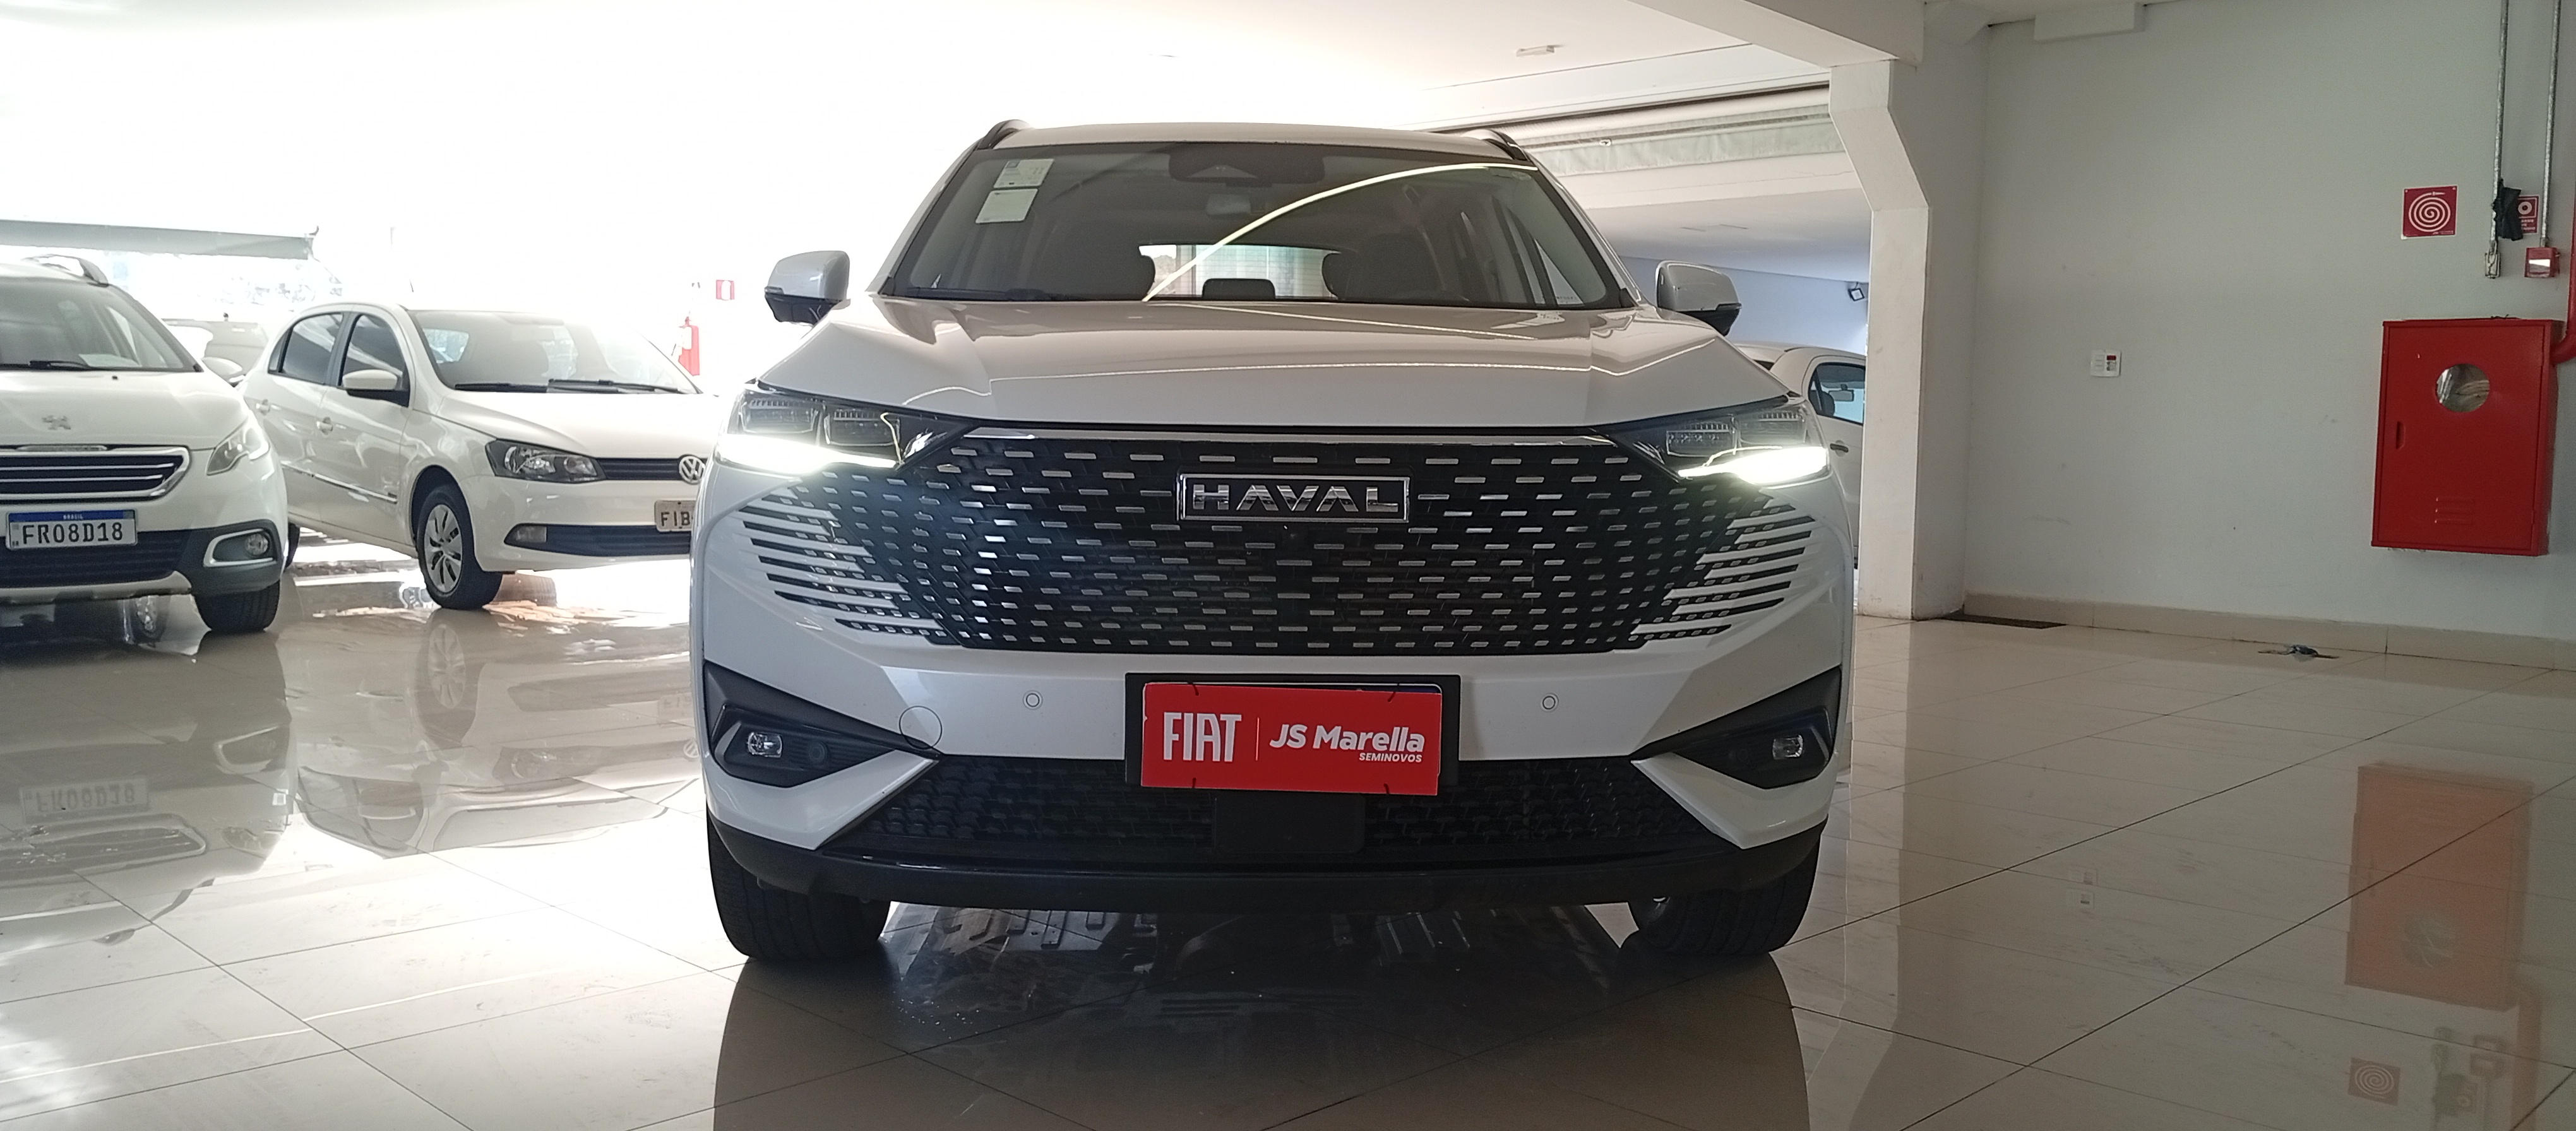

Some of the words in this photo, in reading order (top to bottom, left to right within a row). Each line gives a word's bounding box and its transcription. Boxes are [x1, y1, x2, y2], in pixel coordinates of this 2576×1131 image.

[1192, 484, 1399, 512] HAVAL
[1163, 711, 1243, 762] FIAT
[1269, 724, 1308, 749] JS
[1312, 725, 1426, 753] Marella
[1359, 752, 1422, 763] SEMINOVOS
